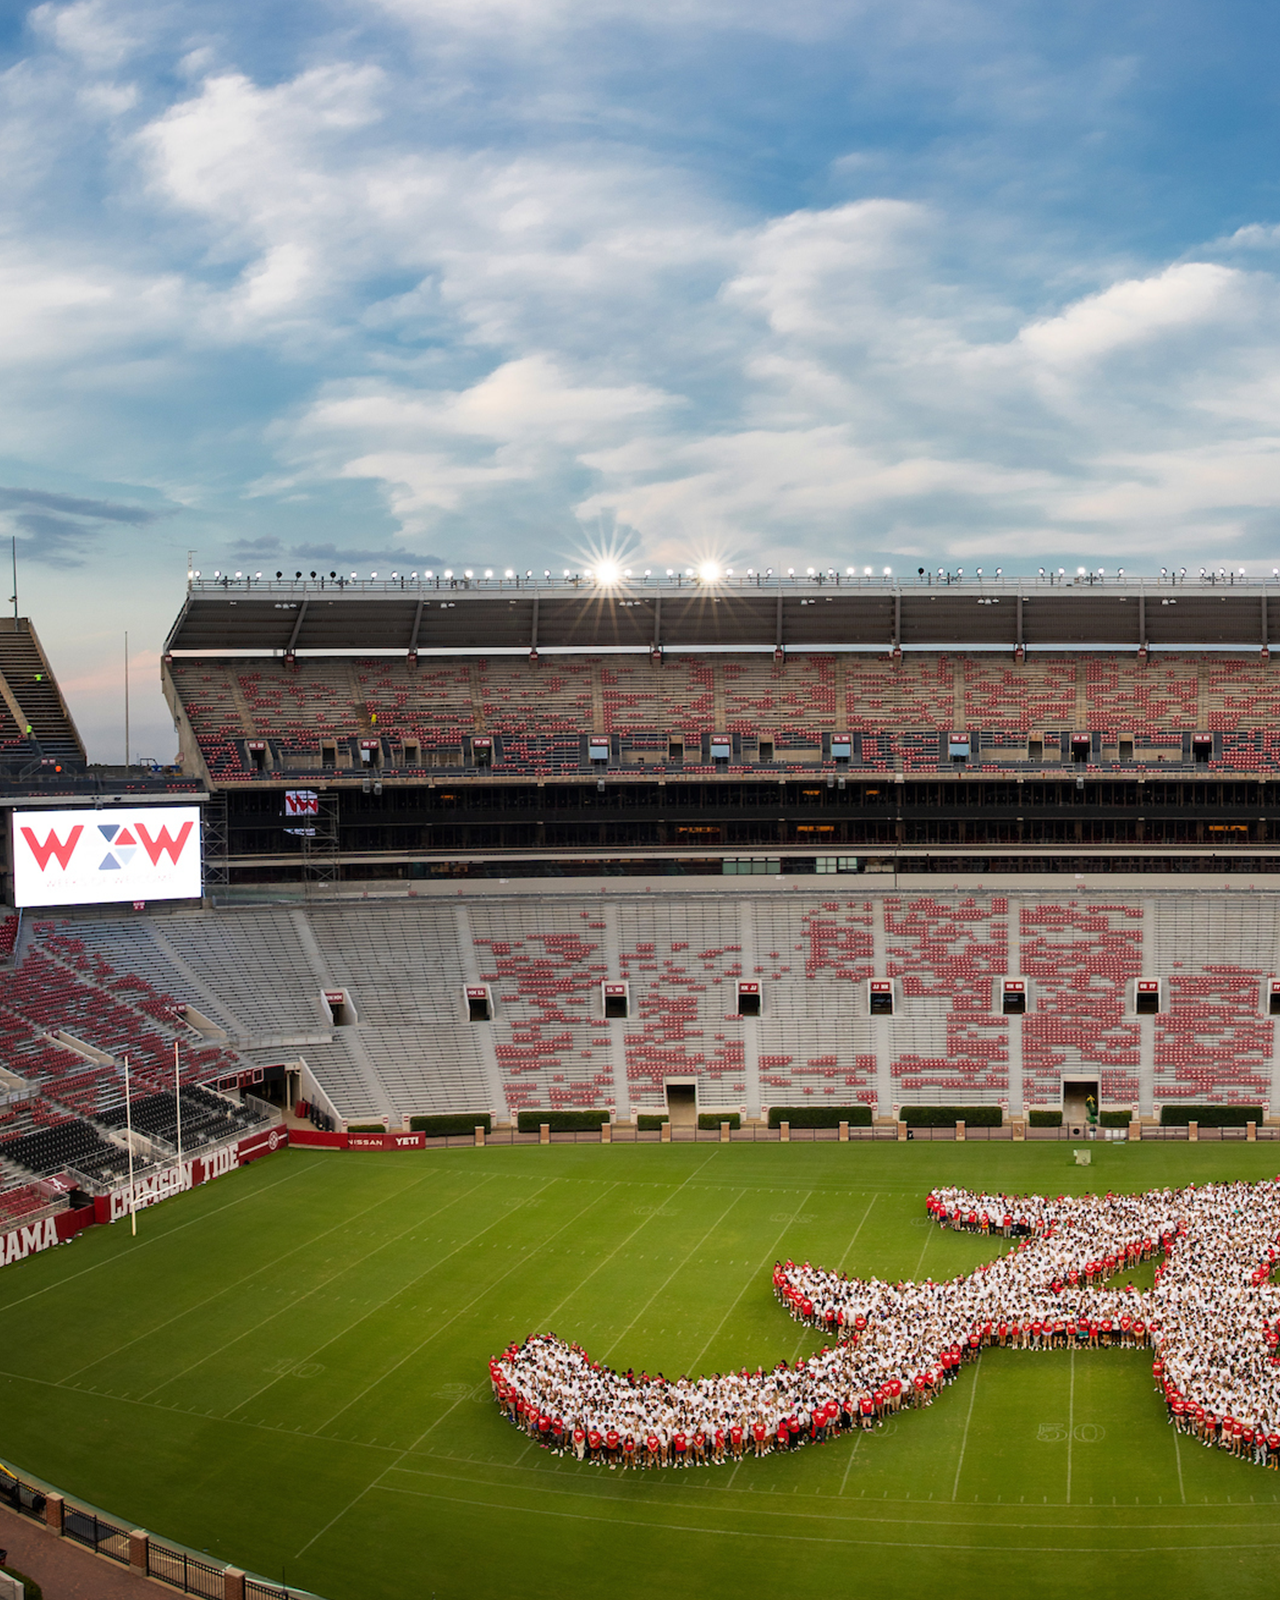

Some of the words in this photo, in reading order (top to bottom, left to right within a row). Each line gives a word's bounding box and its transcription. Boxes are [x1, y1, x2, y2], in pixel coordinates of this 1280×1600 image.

[395, 1136, 419, 1146] YETI
[110, 1161, 193, 1220] CRIMSON
[200, 1143, 239, 1182] TIDE
[1035, 1422, 1106, 1443] 50
